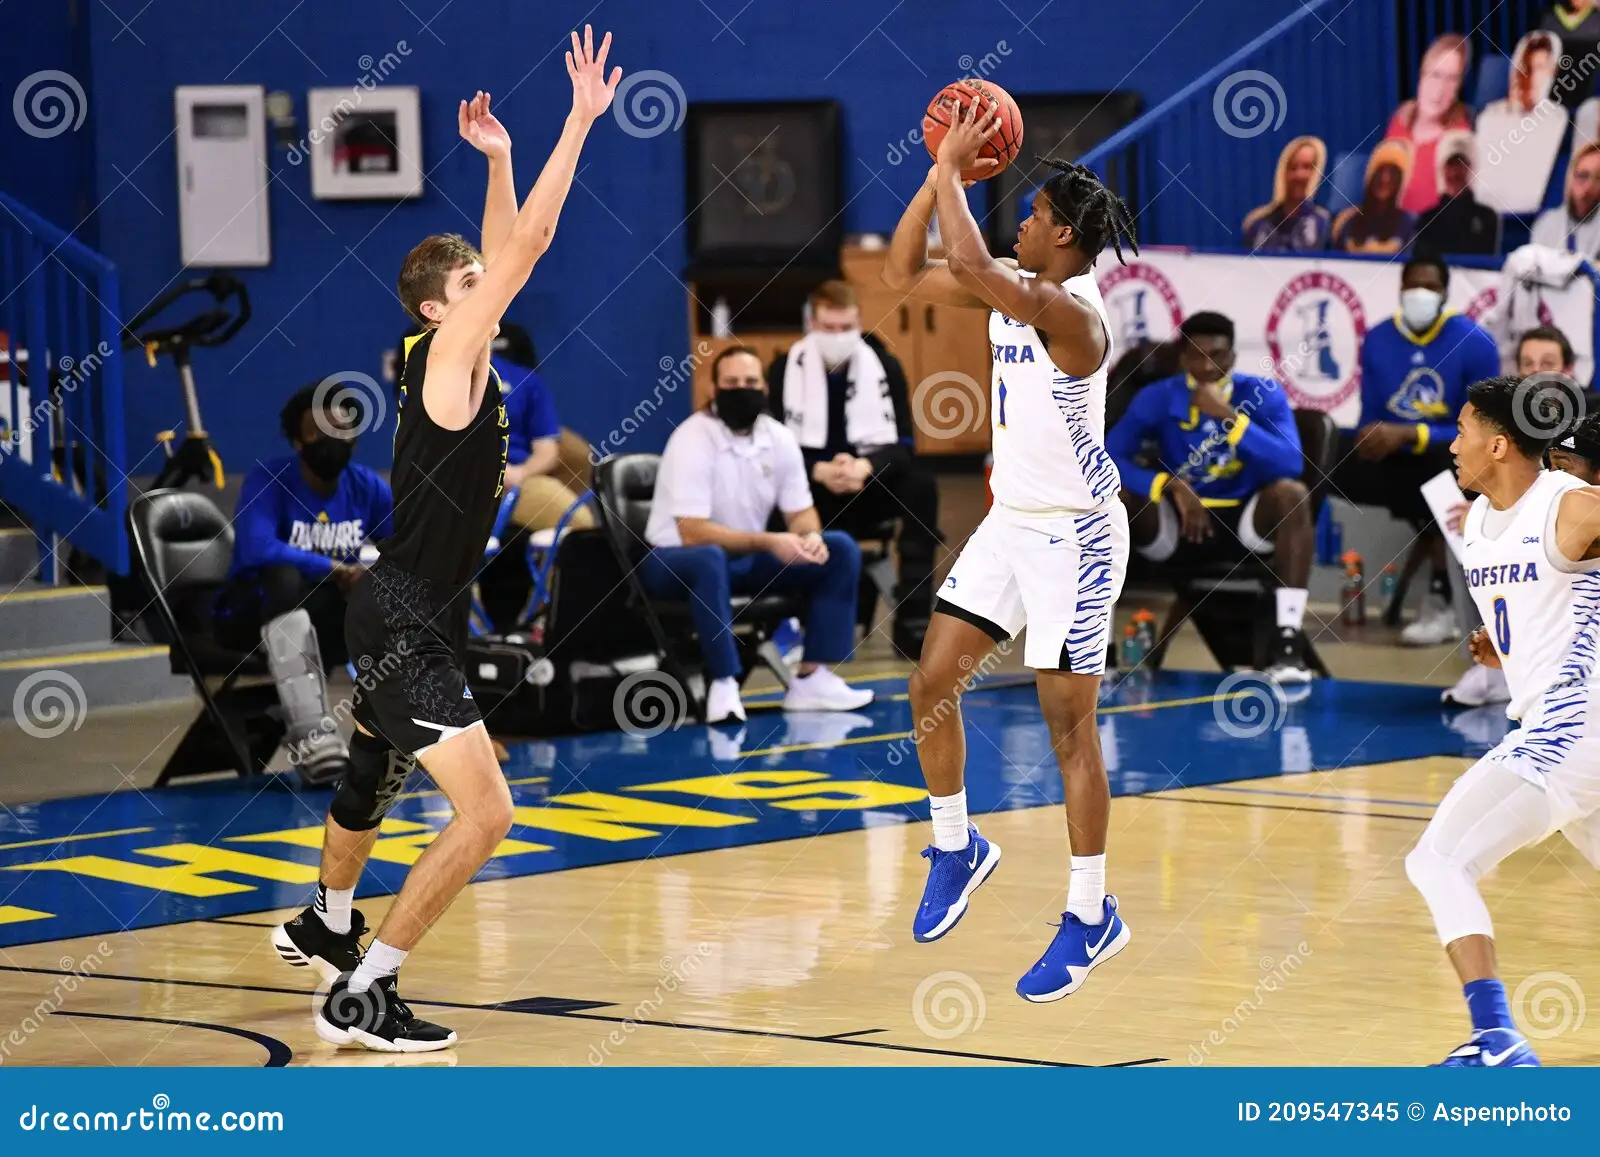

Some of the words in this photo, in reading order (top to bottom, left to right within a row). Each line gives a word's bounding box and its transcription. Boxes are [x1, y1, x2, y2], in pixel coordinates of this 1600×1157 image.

[288, 519, 364, 551] DLAWARE
[1464, 562, 1539, 588] HOFSTRA
[1492, 595, 1511, 659] 0
